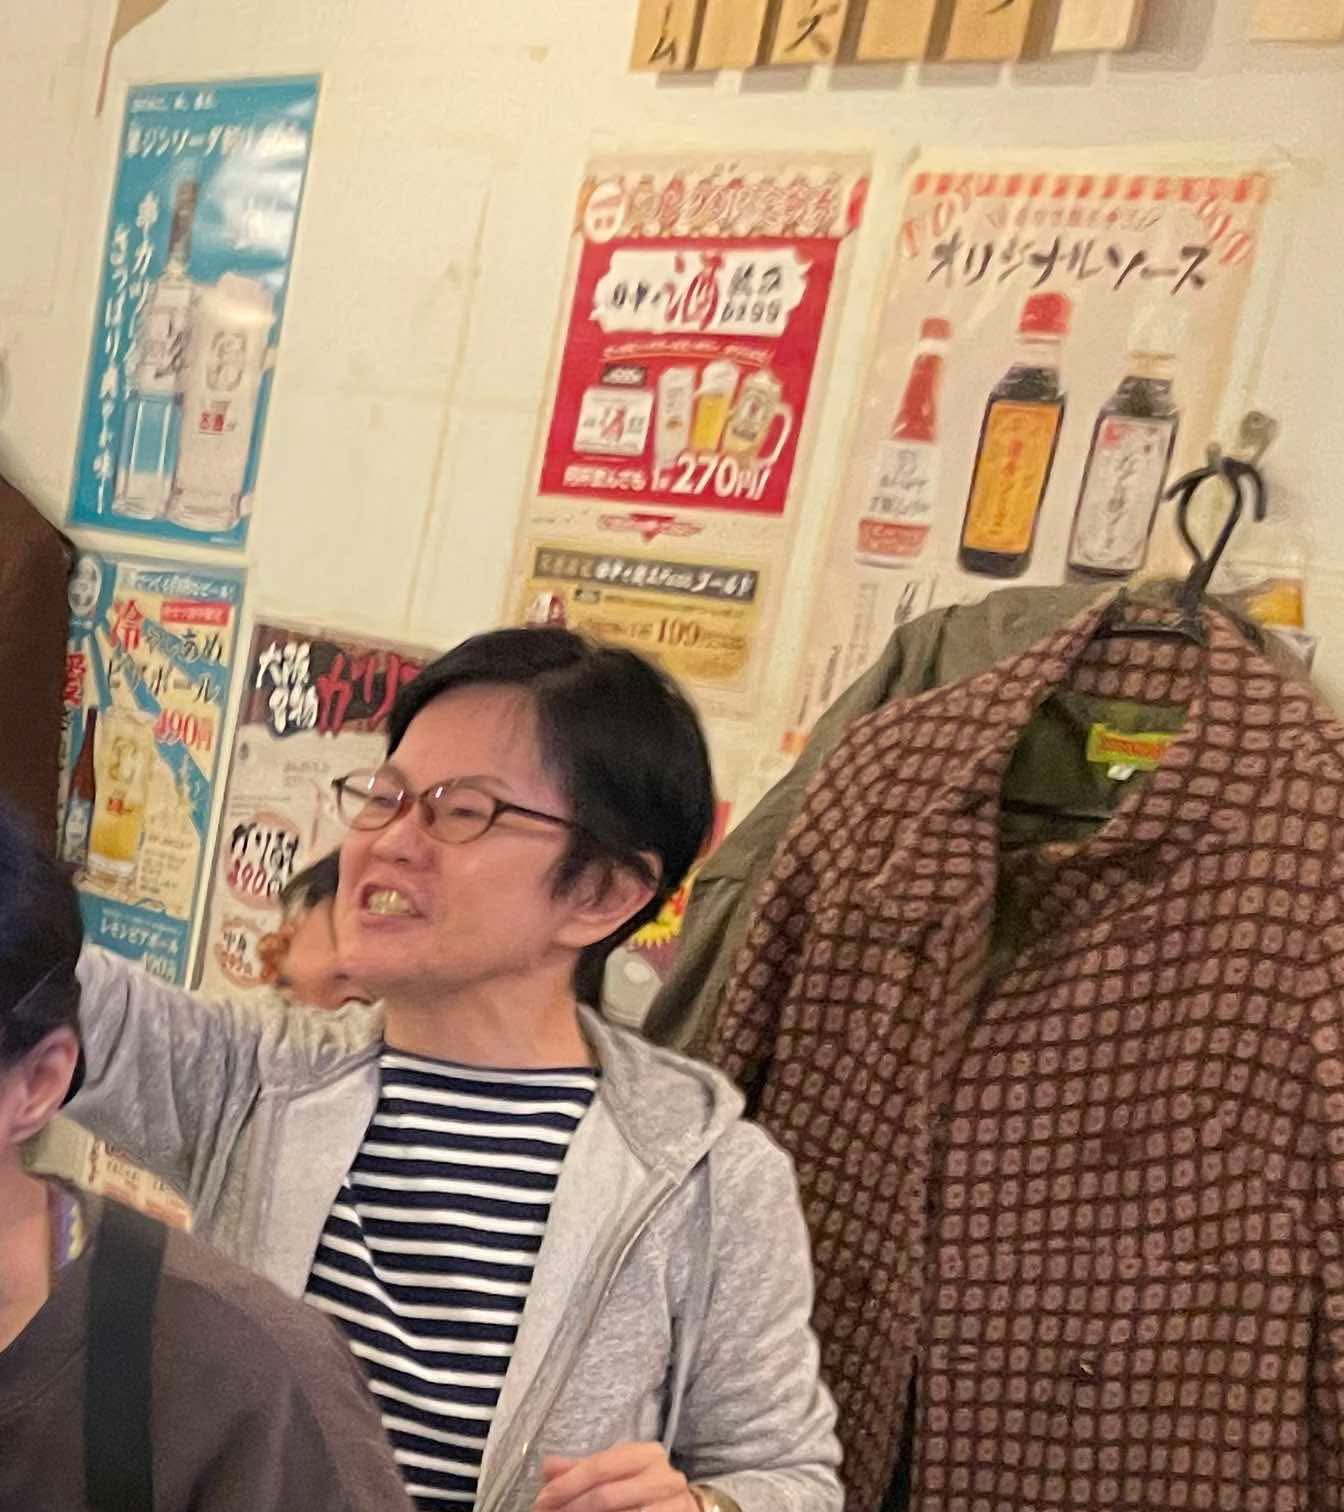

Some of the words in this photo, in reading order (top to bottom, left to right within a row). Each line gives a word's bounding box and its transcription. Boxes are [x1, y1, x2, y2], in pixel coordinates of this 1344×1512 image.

[925, 231, 1213, 297] オリジナルソース
[315, 651, 424, 736] ガリ
